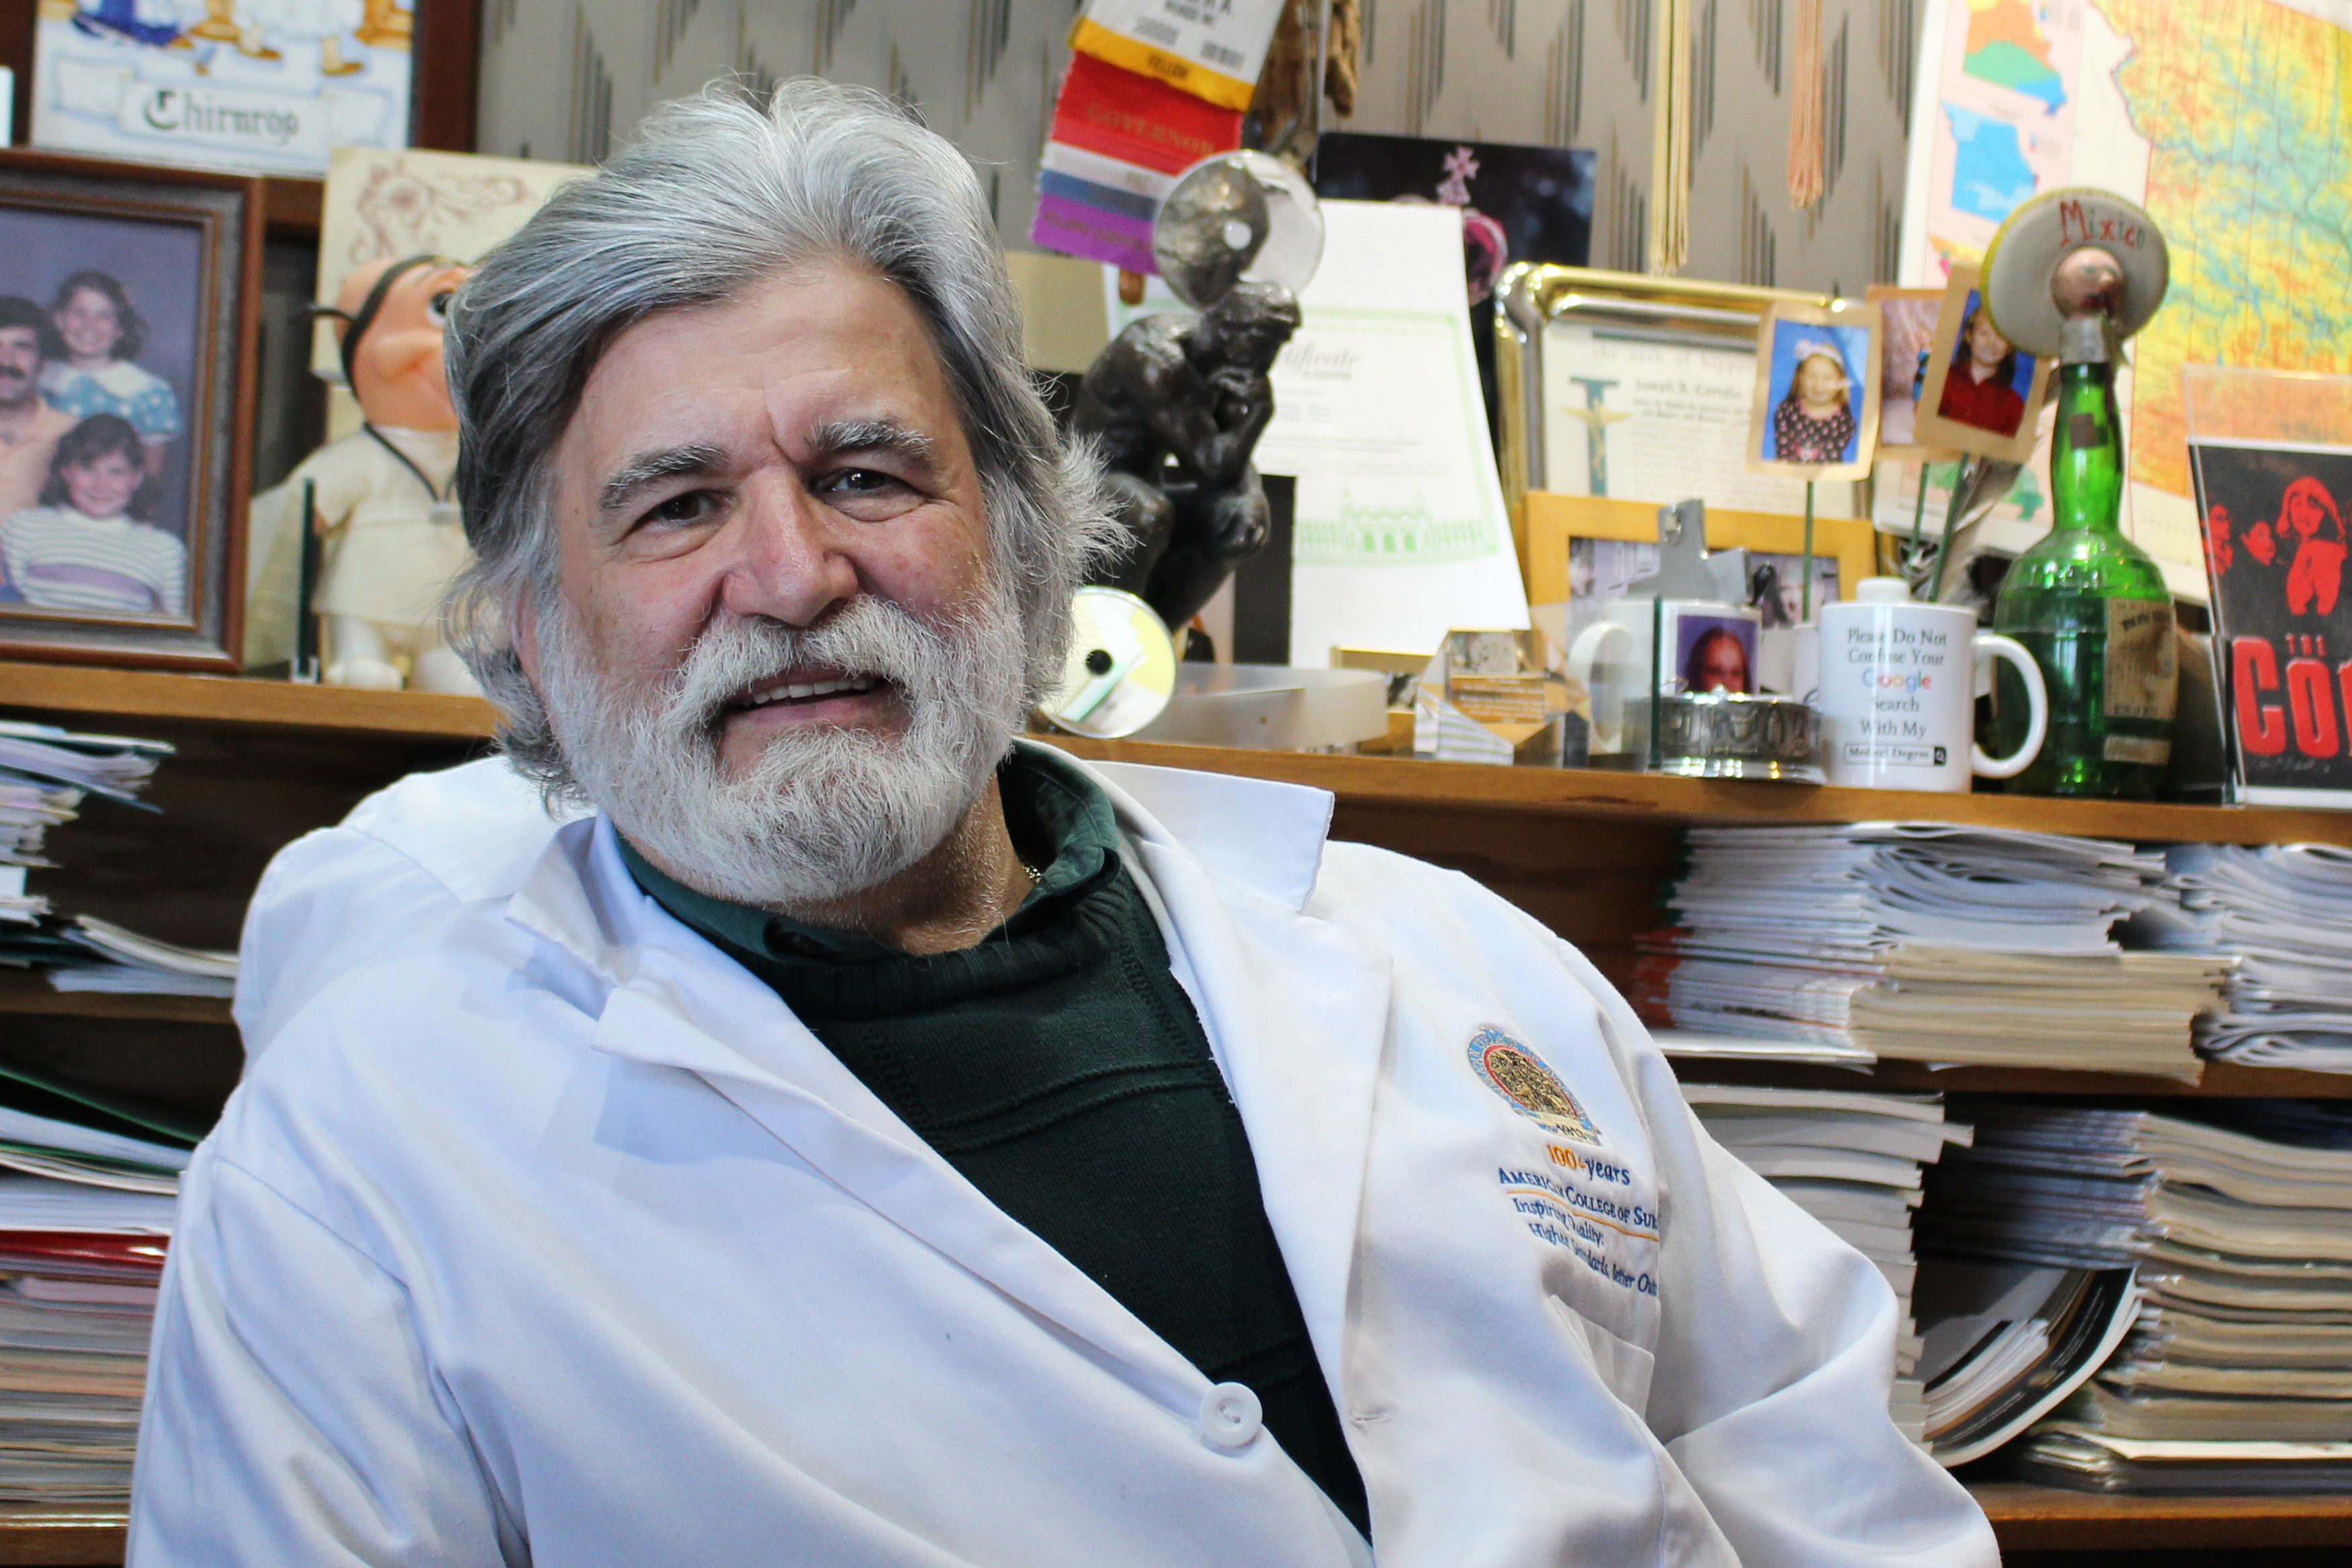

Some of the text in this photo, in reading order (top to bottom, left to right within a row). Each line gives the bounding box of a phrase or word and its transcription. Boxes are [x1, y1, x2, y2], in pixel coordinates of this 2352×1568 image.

[1848, 628, 1947, 646] Pleae Do Not
[2286, 633, 2327, 657] THE
[1913, 649, 1944, 665] Your
[1862, 668, 1932, 694] Google
[1859, 719, 1927, 740] With My
[1849, 747, 1889, 757] Medcal
[1566, 1186, 1617, 1219] COLLEGE
[1617, 1208, 1631, 1224] OF
